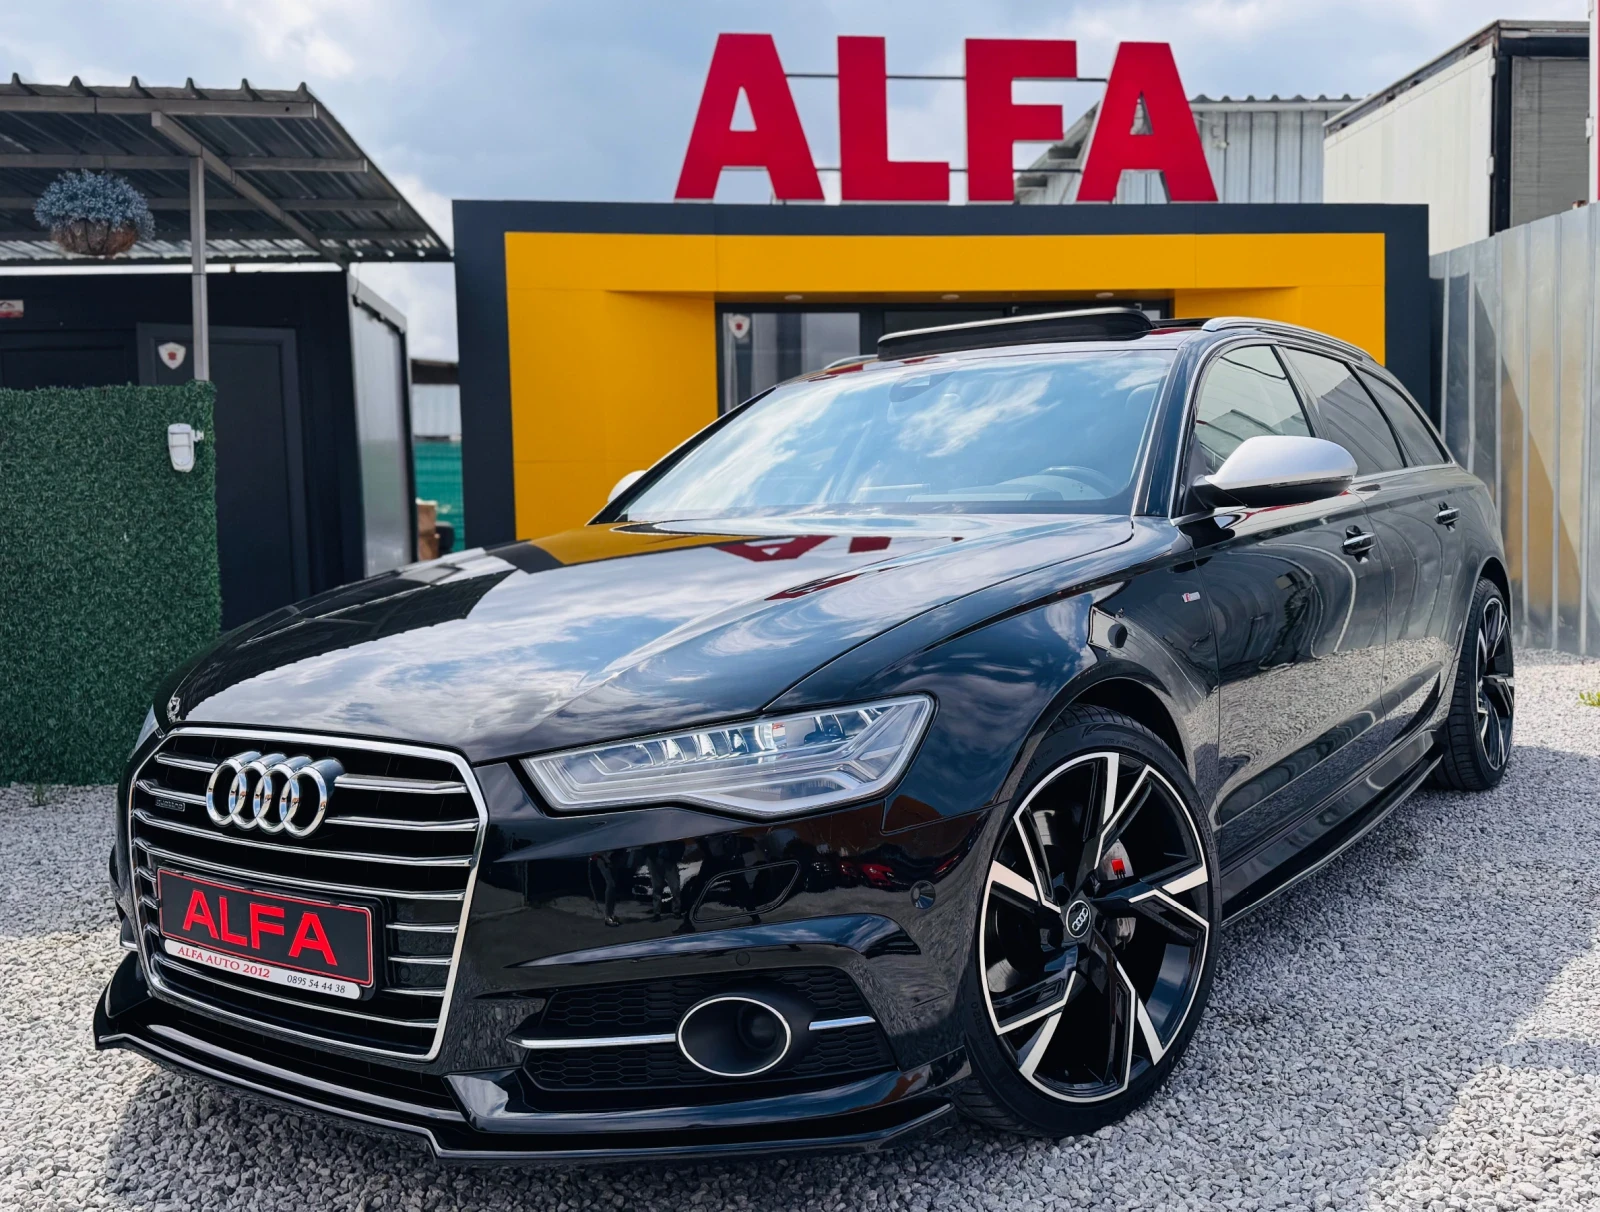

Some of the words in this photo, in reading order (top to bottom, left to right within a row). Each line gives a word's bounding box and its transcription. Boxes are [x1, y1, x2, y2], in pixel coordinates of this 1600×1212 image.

[674, 33, 1219, 200] ALFA
[182, 889, 338, 967] ALFA
[177, 946, 204, 961] ALFA
[203, 954, 240, 971] AUTO
[242, 963, 270, 978] 2012
[286, 974, 307, 987] 0895
[308, 979, 320, 989] 54
[321, 981, 333, 992] 44
[334, 983, 346, 994] 38
